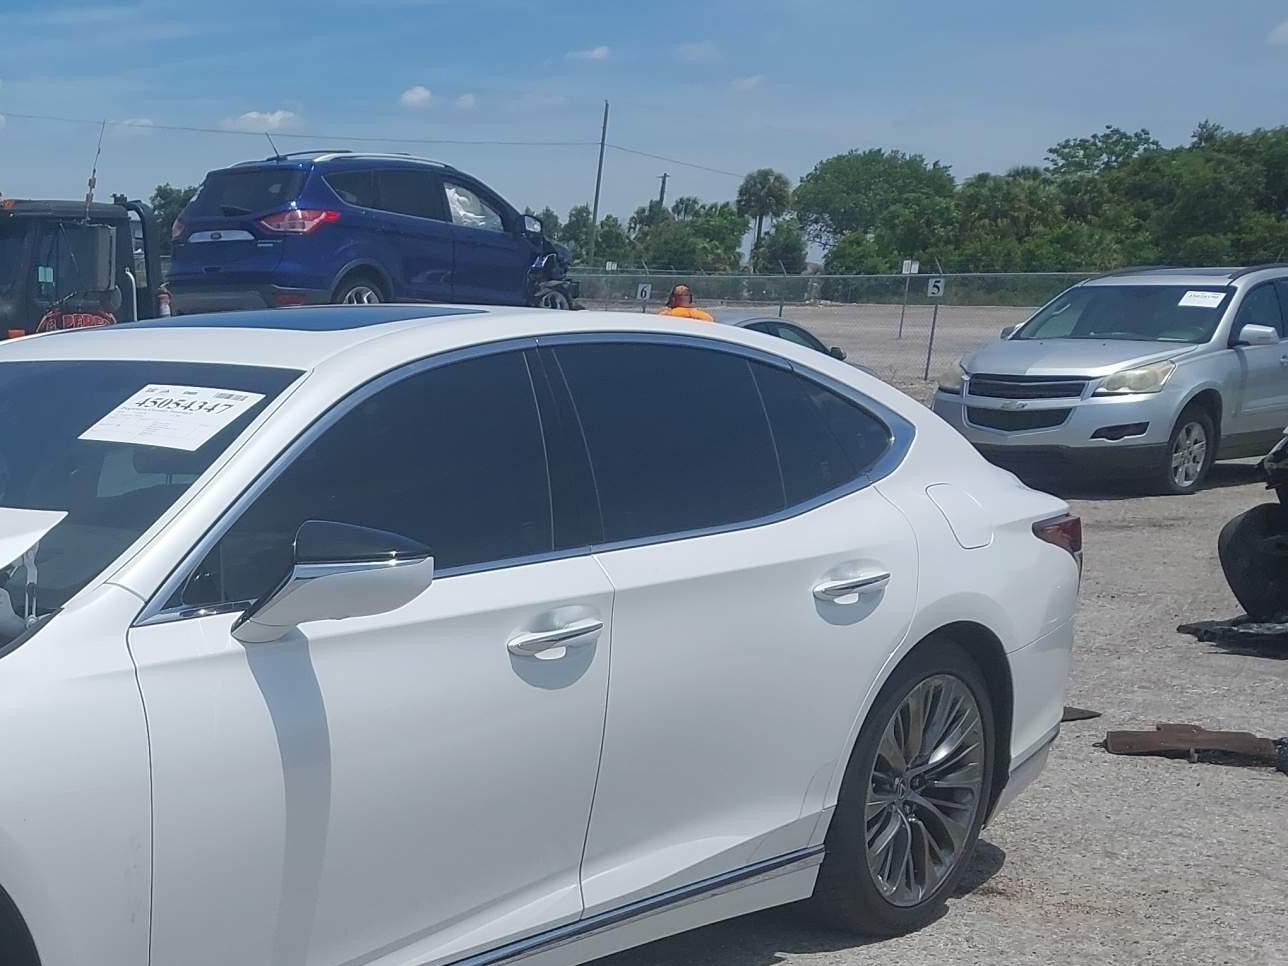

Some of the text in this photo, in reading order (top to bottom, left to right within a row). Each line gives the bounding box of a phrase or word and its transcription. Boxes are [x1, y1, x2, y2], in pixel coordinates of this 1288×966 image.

[640, 285, 648, 299] 6
[931, 280, 941, 295] 5
[135, 397, 234, 414] 45054347
